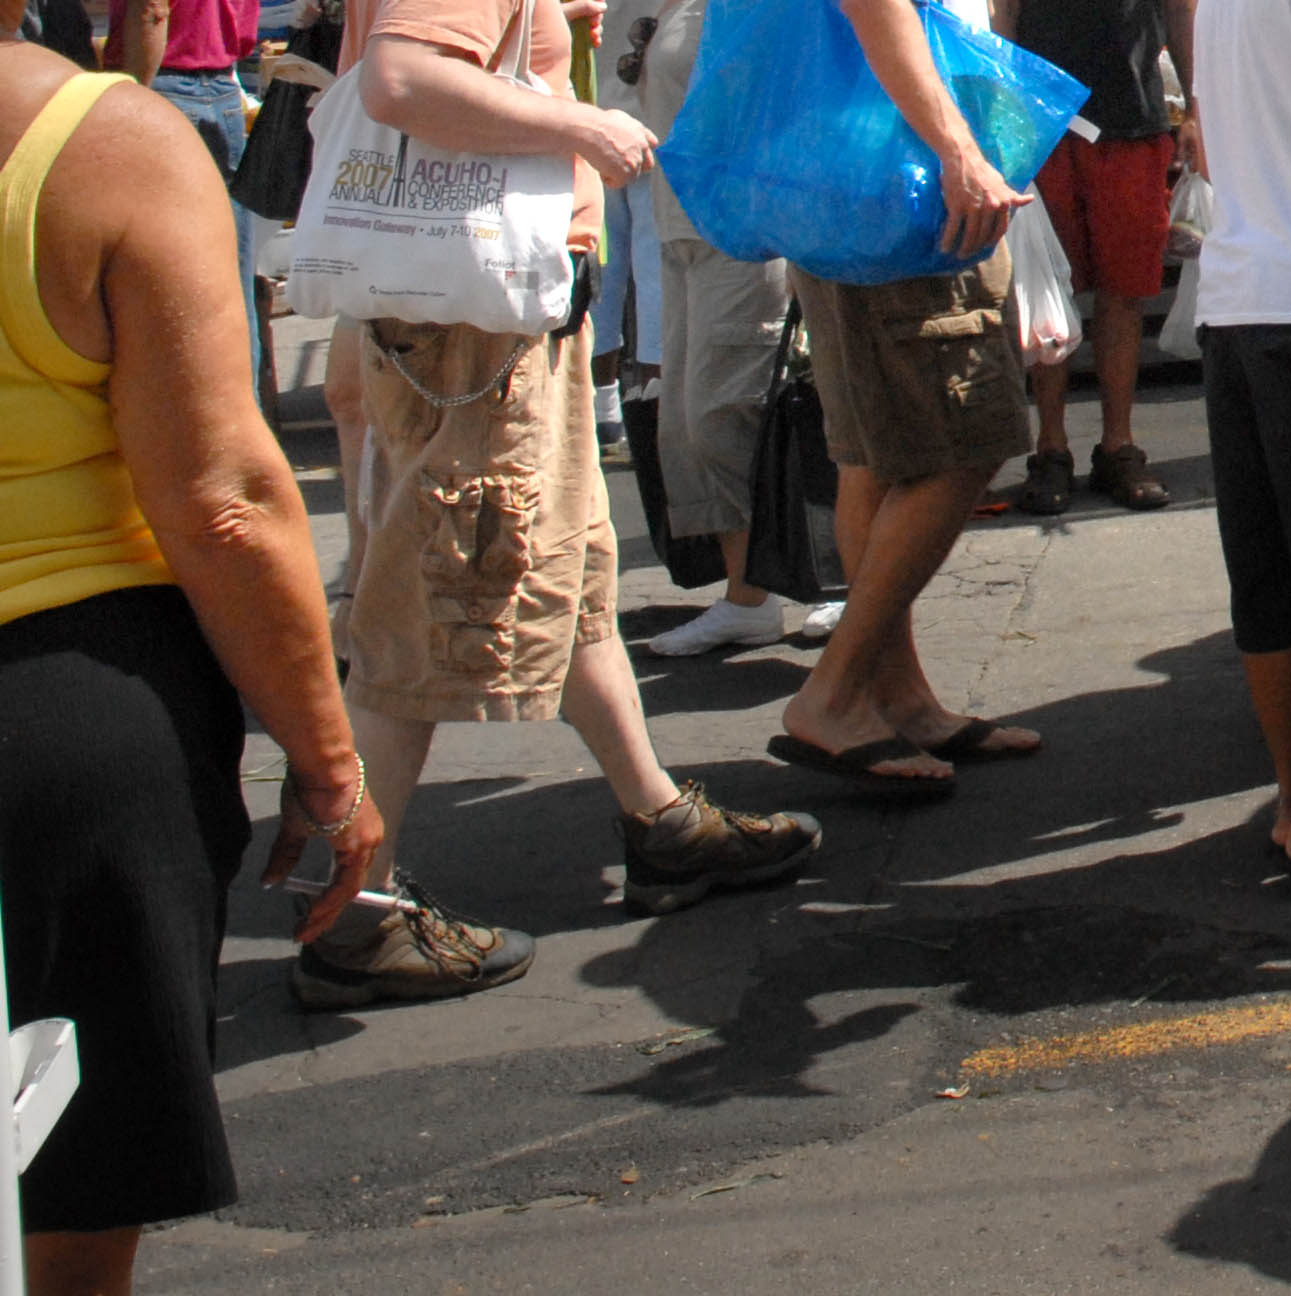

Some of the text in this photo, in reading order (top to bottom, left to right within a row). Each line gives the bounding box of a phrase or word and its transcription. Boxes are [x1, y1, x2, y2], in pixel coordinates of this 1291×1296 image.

[348, 148, 394, 165] SEATTLE
[336, 160, 393, 191] 2007
[411, 159, 507, 189] ACUHO-I
[328, 185, 390, 206] ANNUAL
[407, 181, 505, 203] CONFERENCE
[407, 196, 504, 216] & EXPOSITION
[323, 214, 499, 241] Innovation Gateway July 7-10 2007
